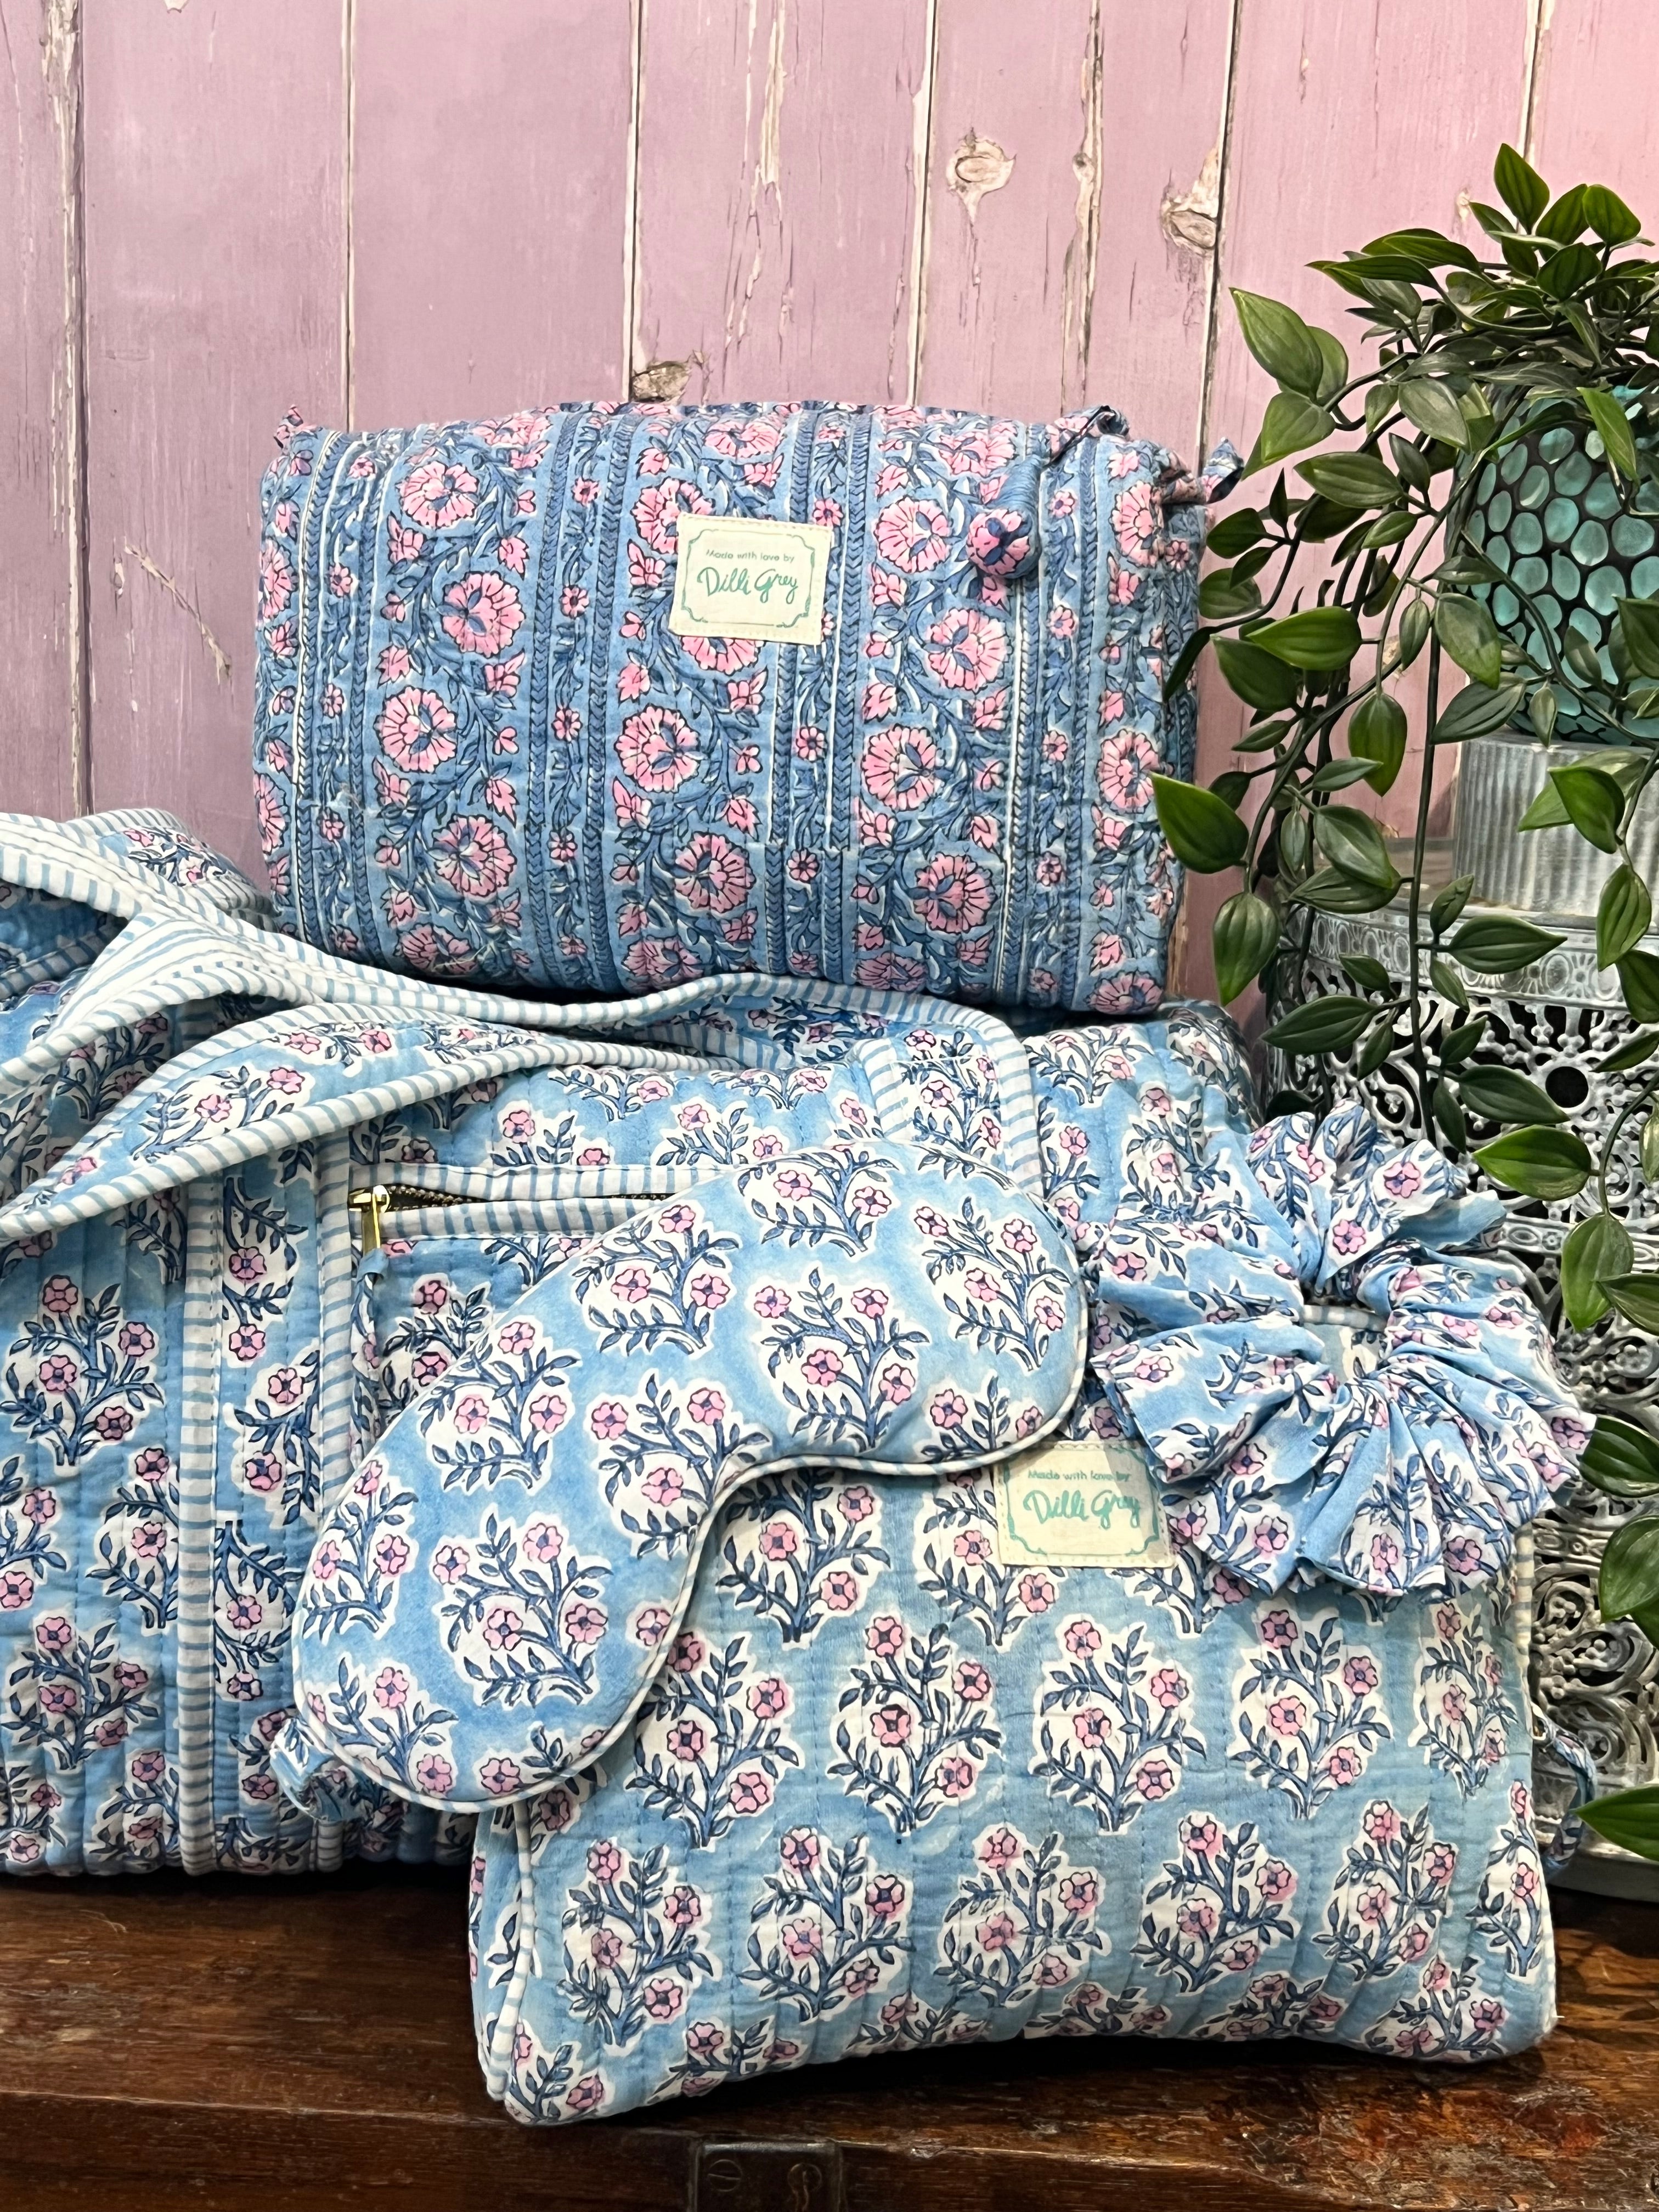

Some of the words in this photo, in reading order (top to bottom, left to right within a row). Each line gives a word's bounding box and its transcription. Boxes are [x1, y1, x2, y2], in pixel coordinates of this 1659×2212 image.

[706, 549, 733, 559] Made
[737, 551, 757, 560] with
[760, 552, 780, 561] love
[783, 554, 795, 563] by
[697, 567, 751, 597] Dilli
[754, 569, 798, 604] Grey
[1064, 1471, 1087, 1480] with
[1023, 1490, 1089, 1524] Dilli
[1091, 1489, 1140, 1530] Grey
